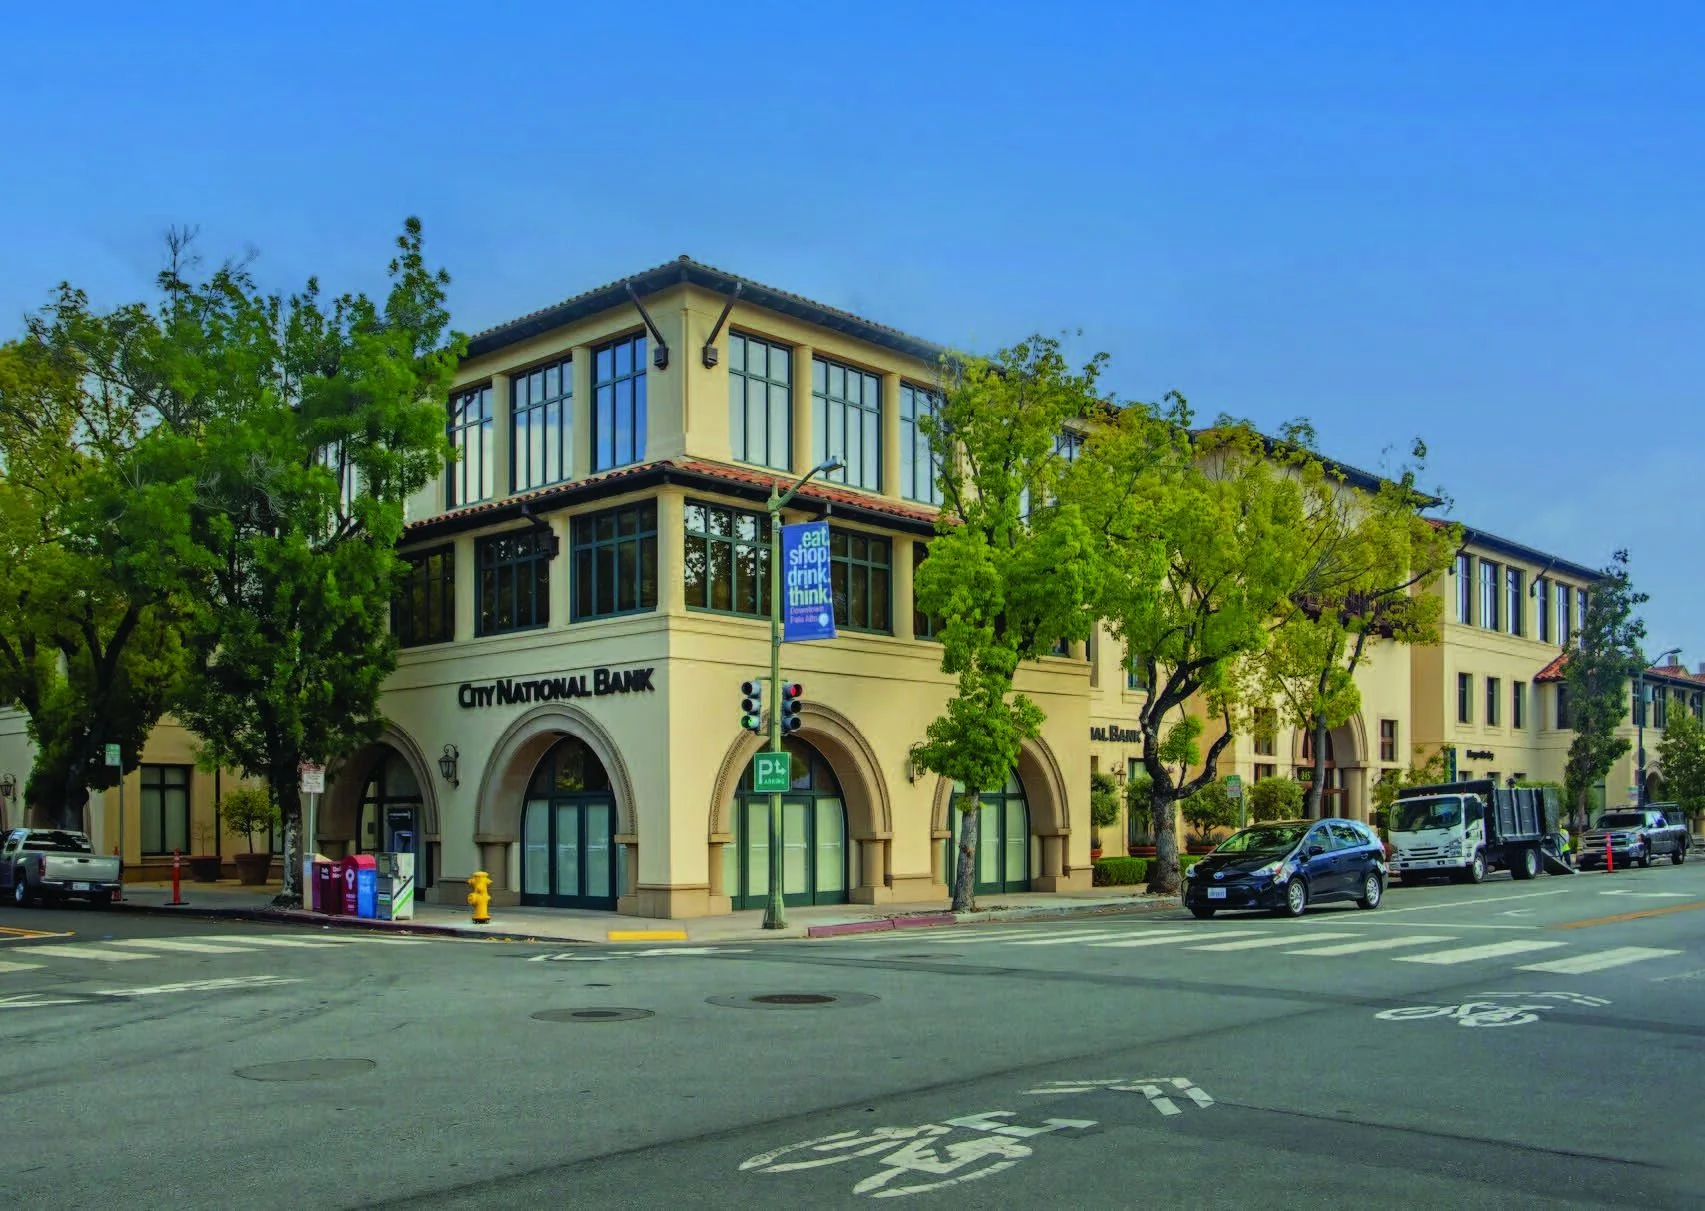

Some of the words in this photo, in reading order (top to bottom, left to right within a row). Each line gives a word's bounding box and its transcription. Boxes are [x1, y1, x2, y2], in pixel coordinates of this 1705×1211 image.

[458, 684, 496, 708] CITY
[496, 675, 592, 705] NATIONAL
[593, 668, 655, 696] BANK
[1109, 725, 1142, 744] BANK
